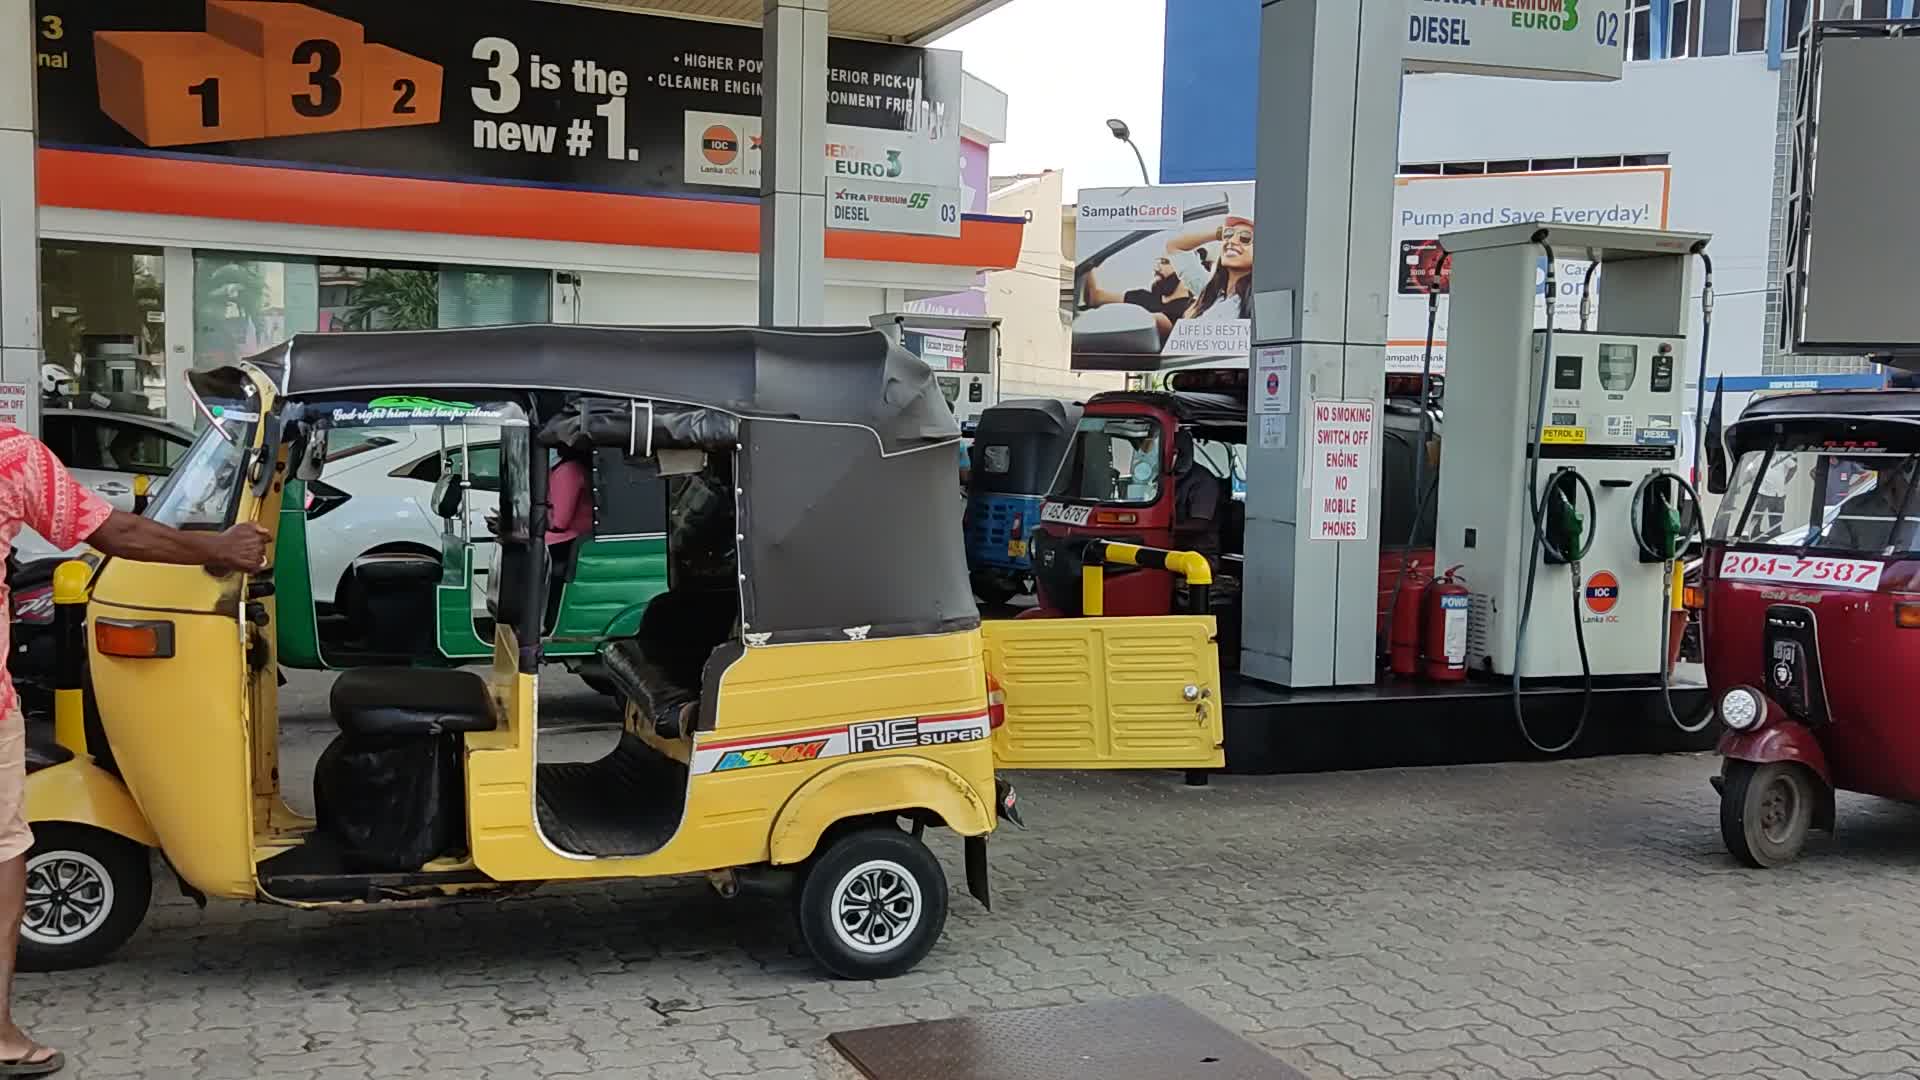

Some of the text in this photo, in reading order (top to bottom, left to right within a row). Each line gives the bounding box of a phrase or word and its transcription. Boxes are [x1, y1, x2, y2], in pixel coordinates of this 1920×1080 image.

[42, 15, 63, 39] 3
[1409, 11, 1618, 46] DIESEL 02
[38, 52, 68, 68] nal
[684, 53, 734, 70] HIGHER
[291, 39, 342, 117] 3
[471, 37, 628, 114] 3 is the
[658, 73, 763, 96] CLEANER ENGIN
[188, 78, 219, 127] 1
[392, 79, 416, 113] 2
[473, 120, 557, 153] new
[711, 140, 729, 150] IOC
[834, 203, 956, 223] DIESEL 03
[1081, 204, 1178, 219] SampathCards
[1402, 204, 1650, 228] Pump and Save Everyday!
[1179, 325, 1200, 336] LIFE
[1203, 325, 1213, 336] IS
[1215, 325, 1241, 336] BEST
[1170, 340, 1209, 351] DRIVES
[1211, 340, 1235, 351] YOU
[1385, 353, 1418, 364] ampath
[0, 385, 25, 395] OKING
[10, 400, 24, 409] OFF
[333, 408, 357, 421] God
[358, 407, 386, 424] right
[386, 407, 411, 418] him
[411, 406, 436, 417] that
[1317, 406, 1371, 422] NO SMOKING
[1318, 430, 1369, 445] SWITCH OFF
[1543, 430, 1573, 438] PETROL
[1326, 453, 1358, 467] ENGINE
[1335, 476, 1348, 491] NO
[1324, 499, 1356, 513] MOBILE
[1322, 521, 1356, 536] PHONES
[1724, 555, 1878, 583] 204-7587
[1594, 587, 1610, 597] IOC
[919, 728, 983, 746] SUPER
